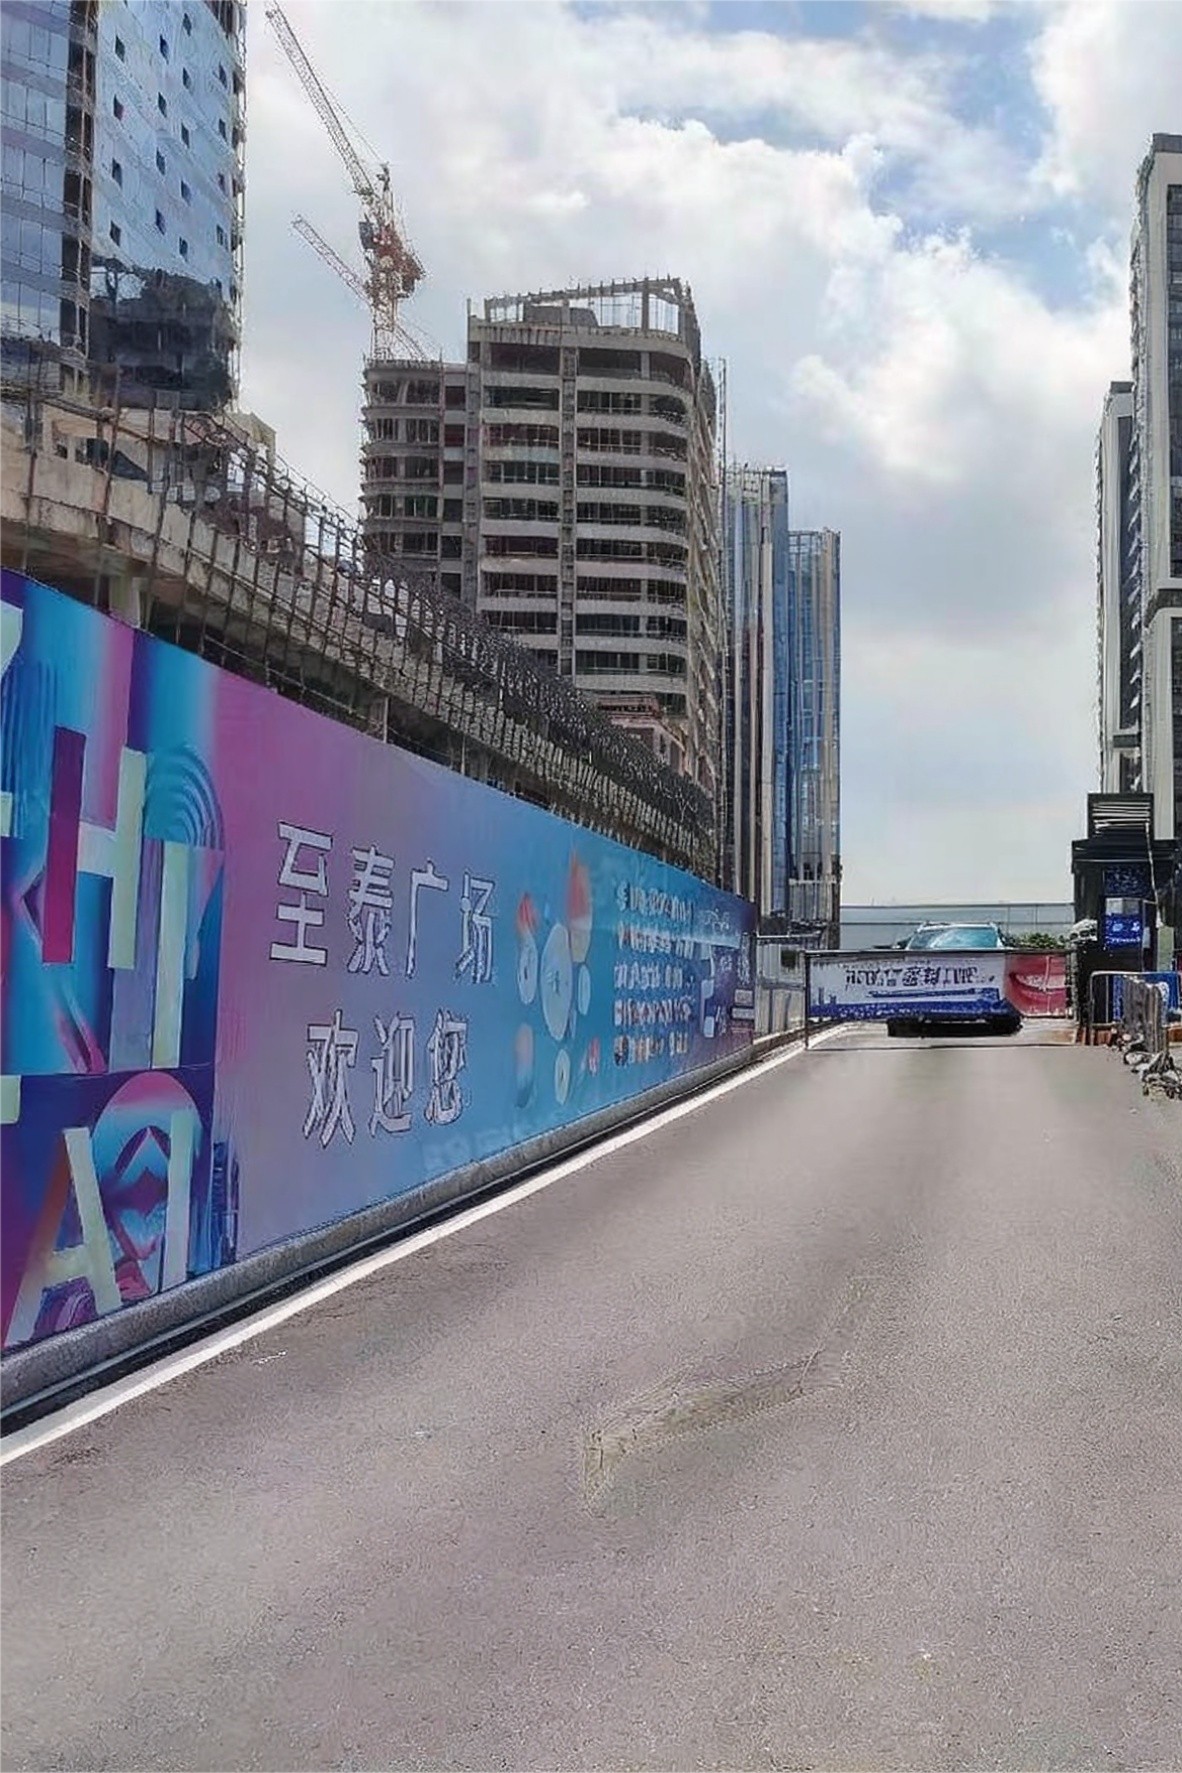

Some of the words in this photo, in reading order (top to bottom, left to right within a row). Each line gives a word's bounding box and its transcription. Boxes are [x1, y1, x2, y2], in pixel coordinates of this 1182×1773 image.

[269, 821, 496, 984] 至泰广场
[303, 1008, 469, 1149] 欢迎您
